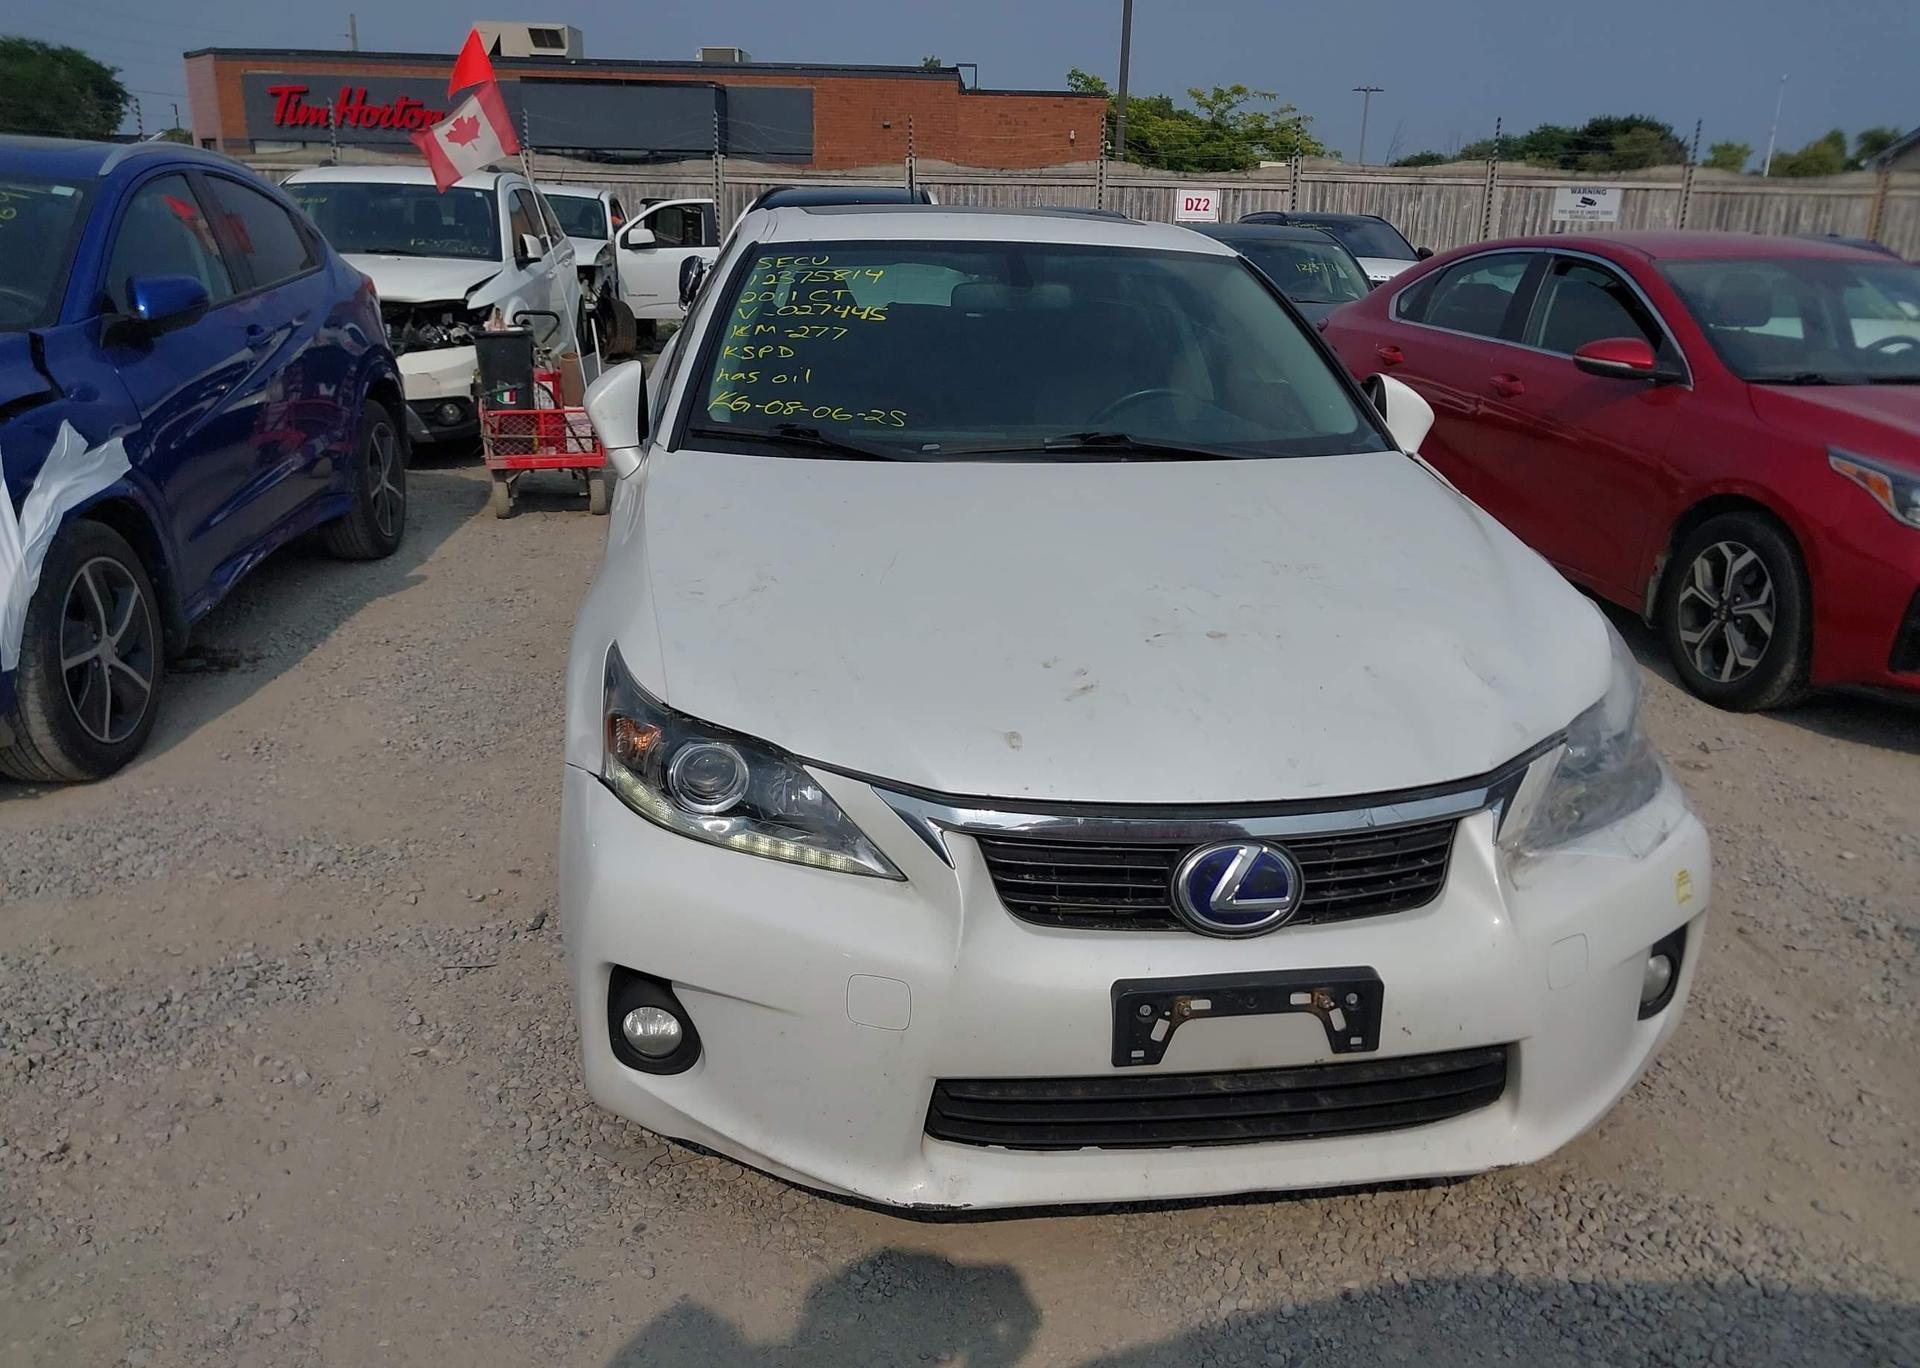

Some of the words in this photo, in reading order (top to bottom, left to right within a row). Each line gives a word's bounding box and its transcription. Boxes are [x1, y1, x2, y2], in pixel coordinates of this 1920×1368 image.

[266, 84, 331, 128] Tim
[332, 86, 444, 130] Horton
[1570, 186, 1607, 196] WARNING
[1185, 197, 1210, 212] DZ2
[758, 256, 830, 270] SECU
[739, 291, 798, 304] 2011
[809, 290, 854, 301] CT
[716, 368, 760, 383] has
[771, 366, 811, 384] oil
